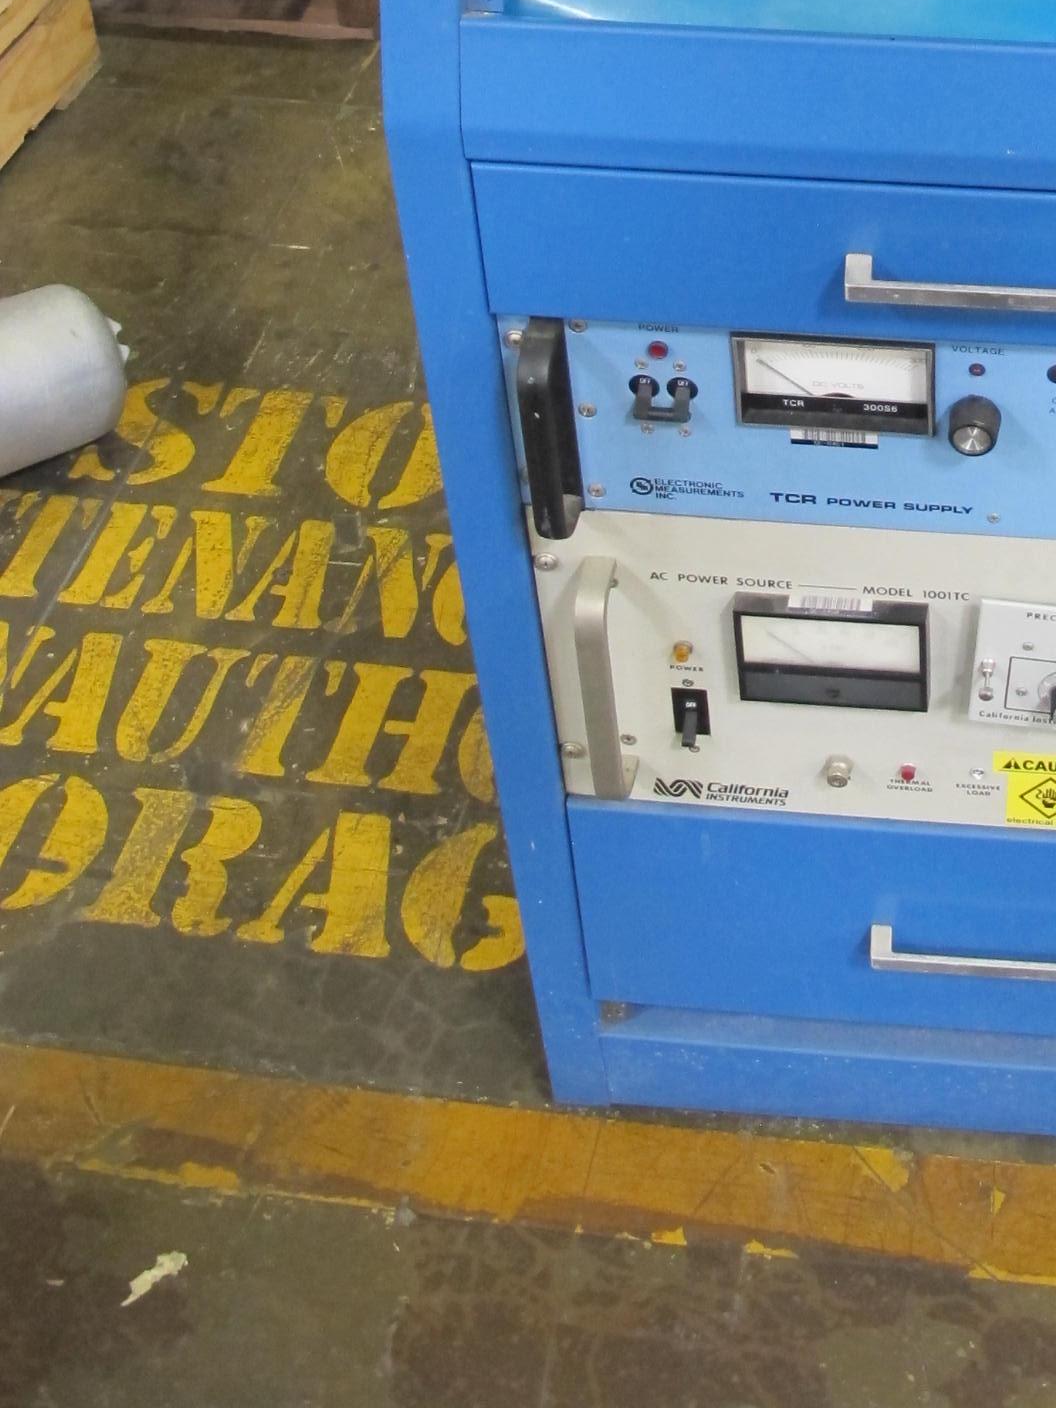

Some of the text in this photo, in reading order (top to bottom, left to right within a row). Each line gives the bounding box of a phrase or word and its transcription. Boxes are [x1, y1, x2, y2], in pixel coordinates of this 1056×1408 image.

[638, 322, 680, 333] POWER
[952, 344, 1006, 356] VOLTAGE
[782, 398, 805, 408] TCR
[654, 478, 723, 490] ELECTRONIC
[654, 485, 745, 498] MEASUREMENTS
[770, 492, 974, 515] TCR POWER SUPPLY
[649, 571, 669, 582] AC
[677, 573, 729, 585] POWER
[736, 577, 794, 590] SOURCE
[862, 586, 913, 598] MODEL
[669, 664, 704, 673] POWER
[979, 711, 1030, 723] California
[707, 781, 790, 799] California
[886, 784, 933, 792] OVERLOAD
[705, 793, 787, 807] INSTRUMENTS
[1005, 816, 1054, 826] electrical
